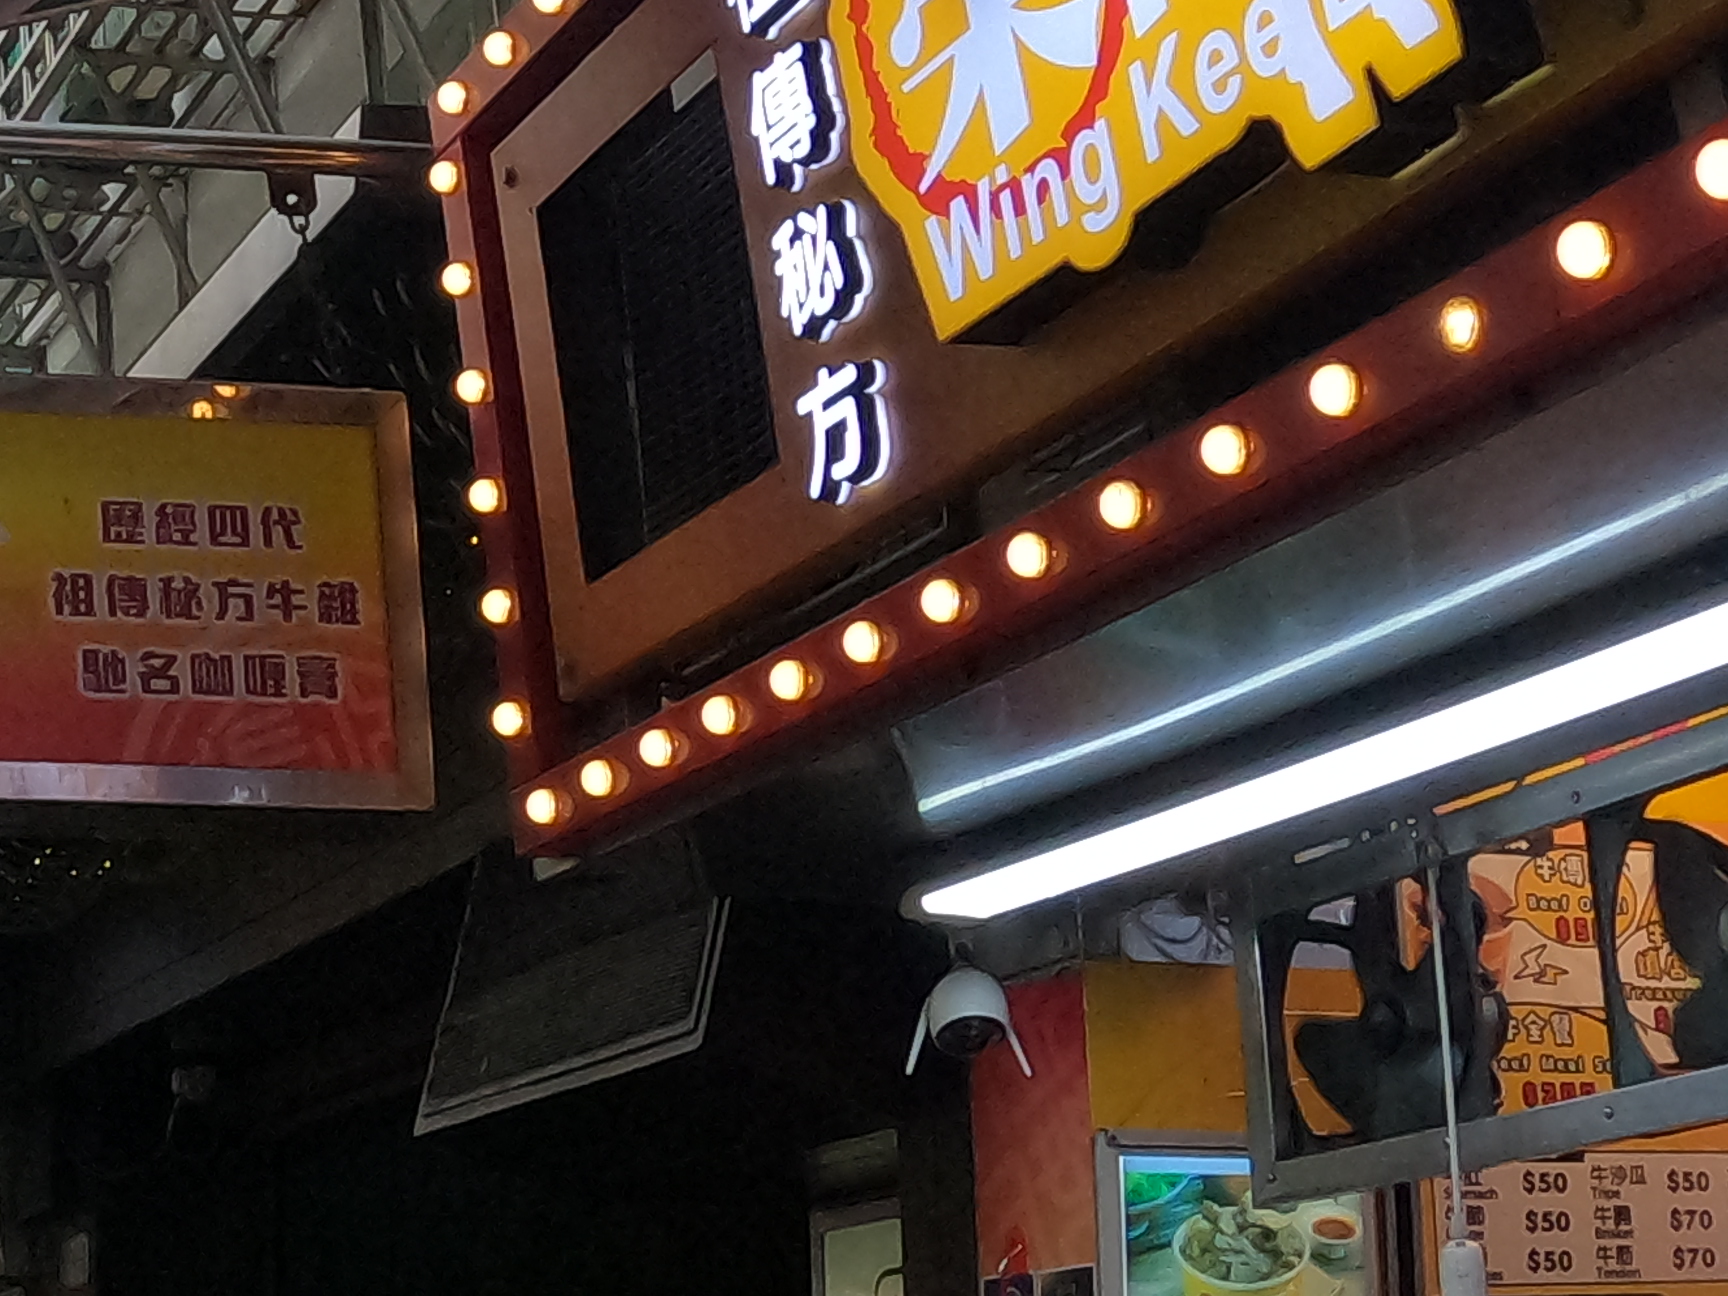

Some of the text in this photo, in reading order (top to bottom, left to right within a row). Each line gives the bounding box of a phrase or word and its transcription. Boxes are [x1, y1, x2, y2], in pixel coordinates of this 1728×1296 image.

[925, 116, 1121, 302] Wing
[1521, 1168, 1569, 1195] $50
[1666, 1168, 1710, 1194] $50
[1525, 1209, 1571, 1235] $50
[1670, 1206, 1714, 1233] $70
[1527, 1247, 1573, 1274] $50
[1672, 1245, 1716, 1272] $70
